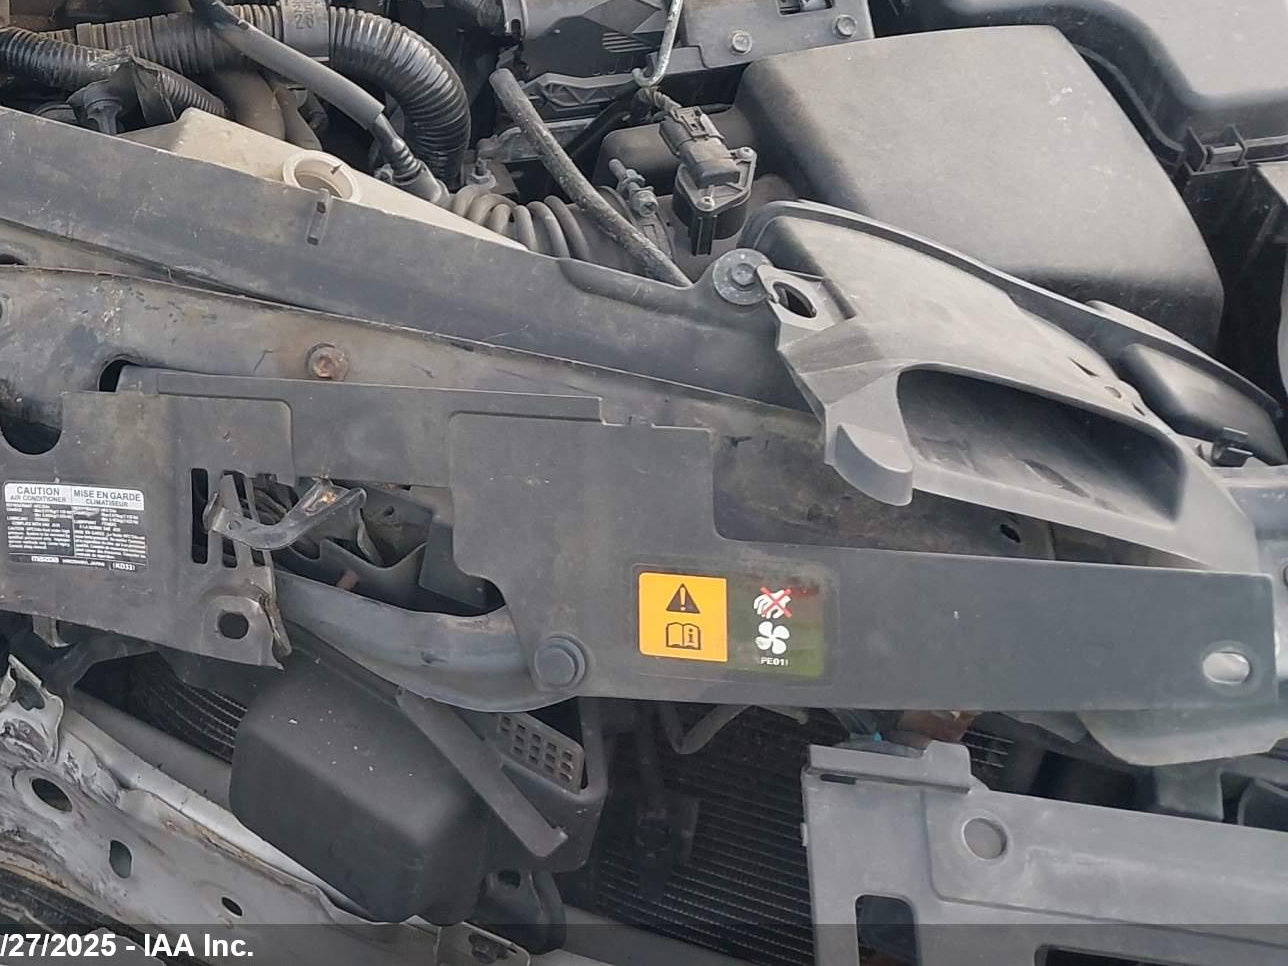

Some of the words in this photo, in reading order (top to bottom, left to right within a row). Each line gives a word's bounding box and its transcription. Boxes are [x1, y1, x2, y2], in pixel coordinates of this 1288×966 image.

[16, 486, 60, 496] CAUTION
[73, 489, 95, 498] MISE
[96, 491, 109, 499] EN
[109, 492, 142, 502] GARDE
[22, 495, 67, 503] CONDITIONER
[85, 498, 129, 507] CLIMATISEUR
